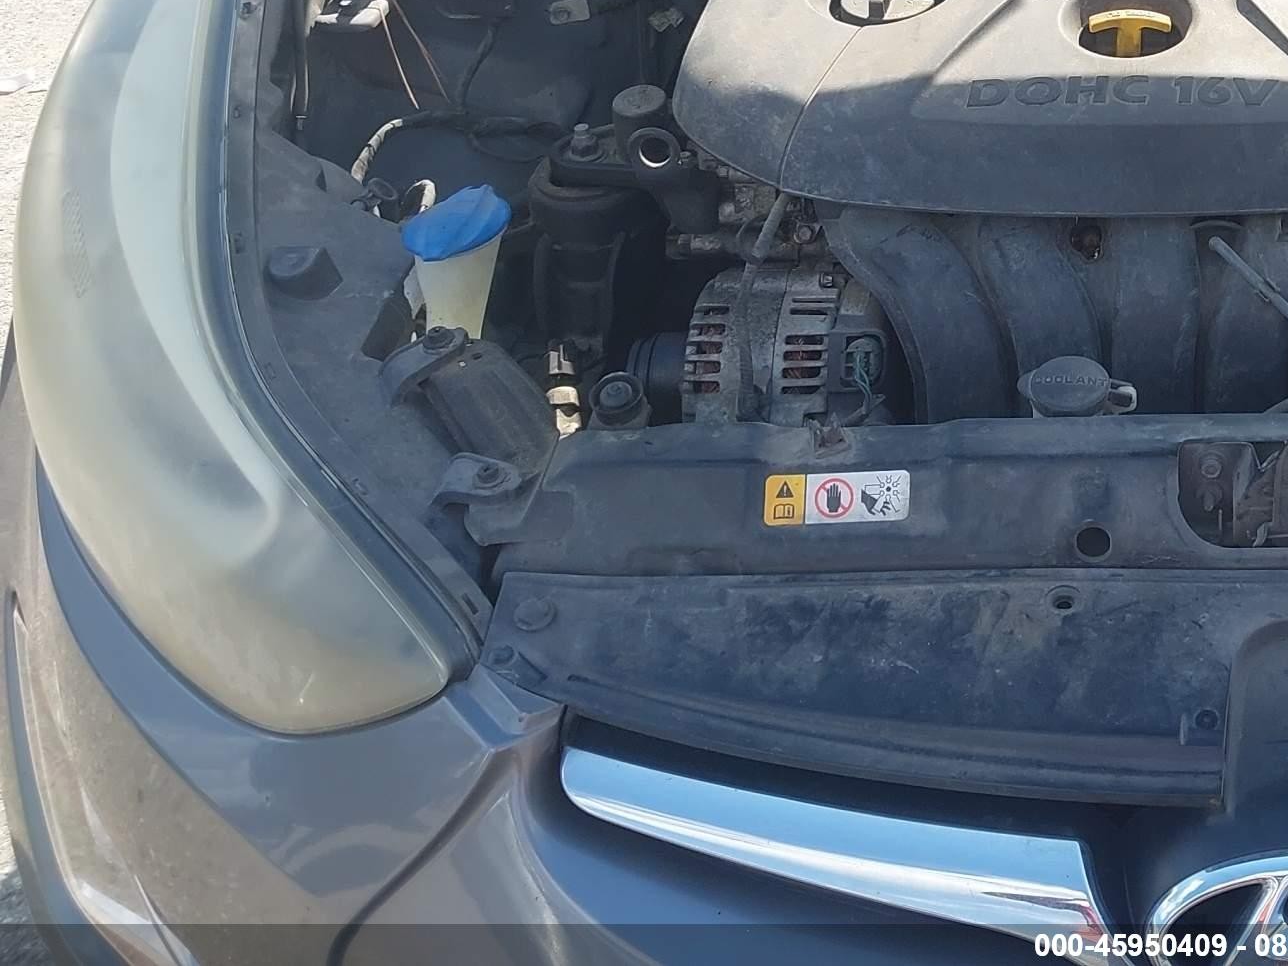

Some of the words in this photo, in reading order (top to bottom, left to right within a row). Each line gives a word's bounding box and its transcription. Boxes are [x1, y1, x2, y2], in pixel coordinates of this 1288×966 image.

[966, 75, 1150, 108] DOHC
[1173, 75, 1280, 107] 16V
[1034, 374, 1108, 388] COOLANT
